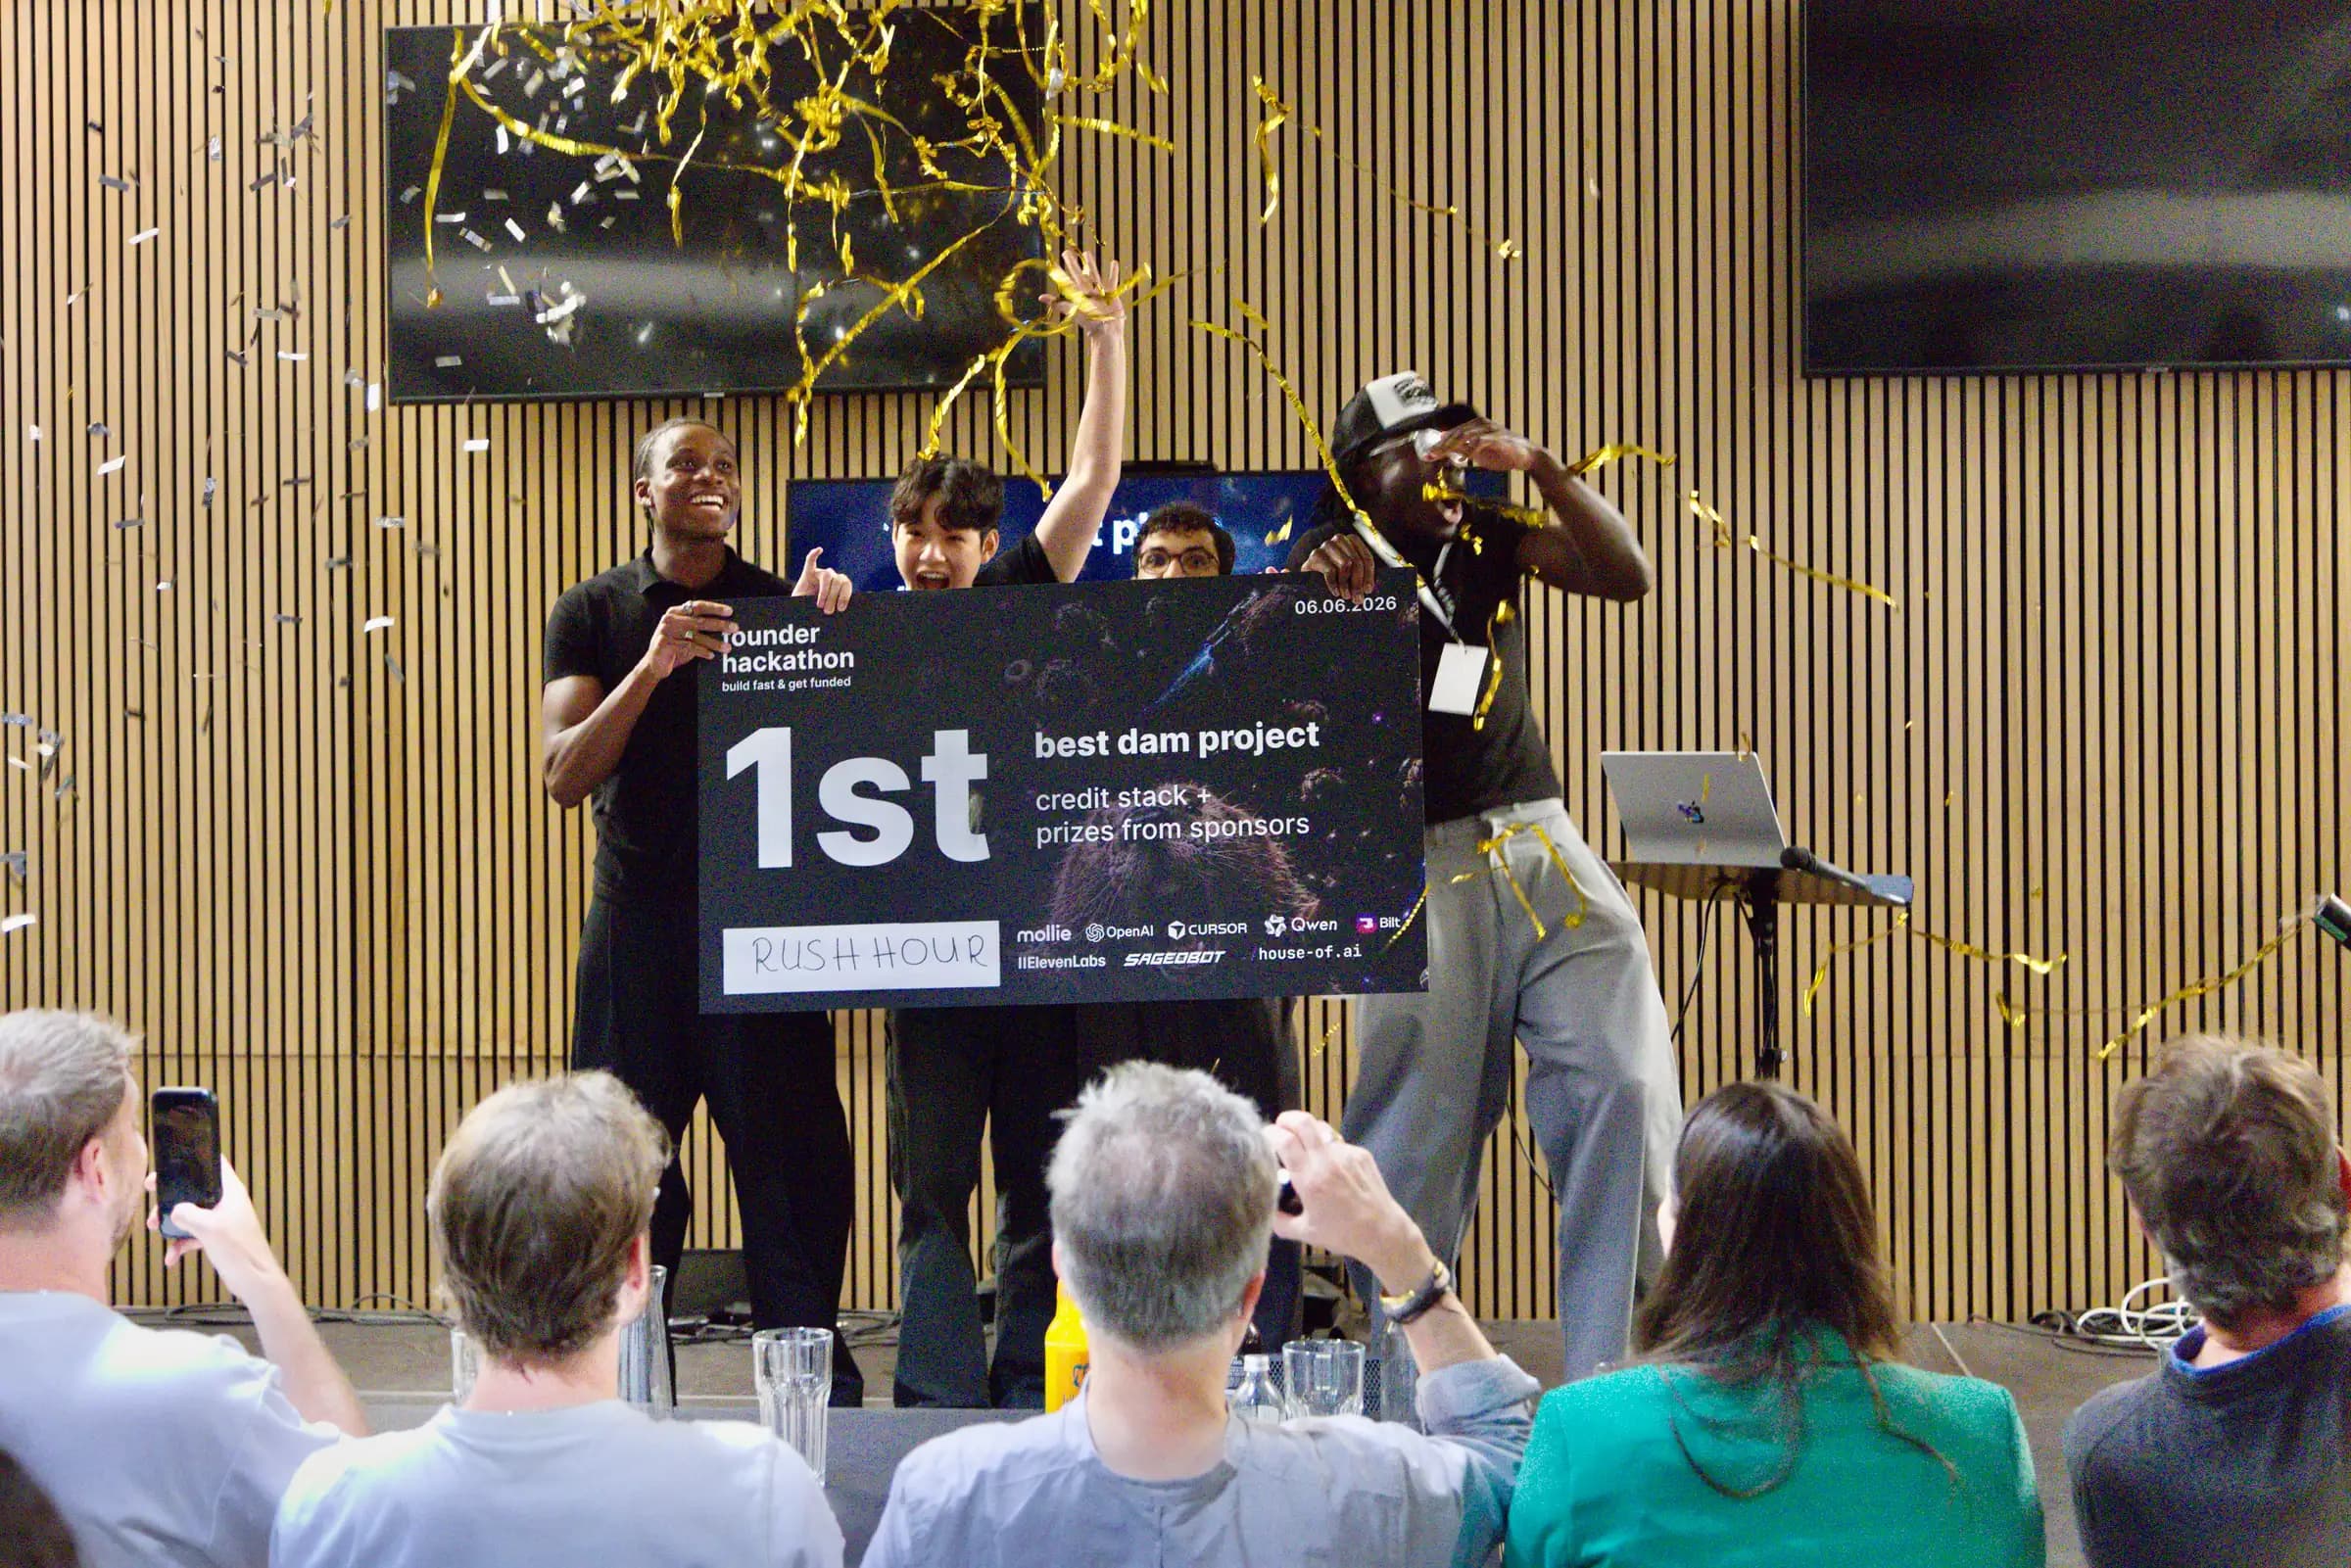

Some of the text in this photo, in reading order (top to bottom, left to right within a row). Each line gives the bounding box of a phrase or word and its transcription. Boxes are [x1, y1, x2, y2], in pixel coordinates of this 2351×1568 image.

[722, 648, 854, 674] hackathon
[722, 676, 851, 692] build fast & get funded
[1034, 721, 1320, 758] best dam project
[726, 726, 990, 869] 1st
[1035, 784, 1212, 811] credit stack +
[1036, 812, 1310, 849] prizes from sponsors
[1188, 923, 1248, 935] CURSOR
[1291, 917, 1338, 932] Qwen
[1379, 916, 1401, 928] Bilt
[1017, 924, 1073, 942] mollie
[1106, 925, 1154, 940] OpenAI
[752, 934, 988, 974] RUSH HOUR
[1259, 943, 1363, 961] house-of.ai
